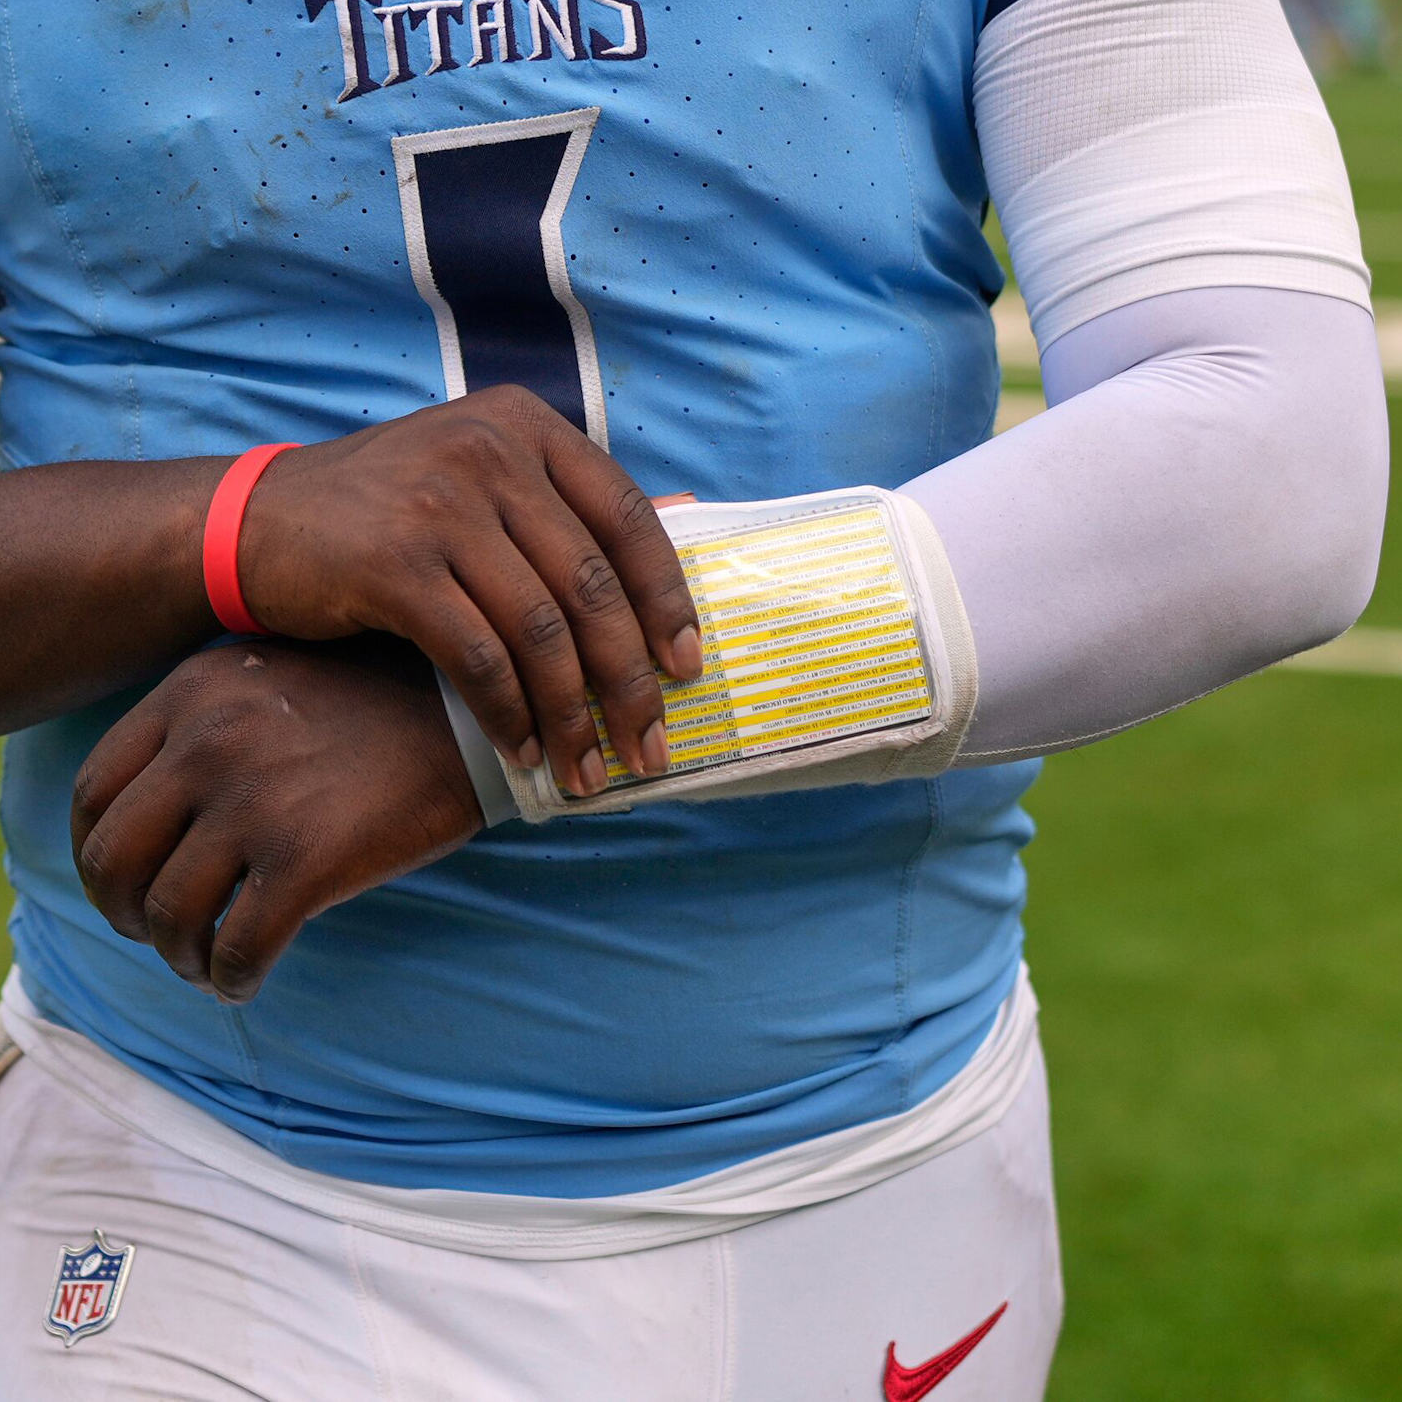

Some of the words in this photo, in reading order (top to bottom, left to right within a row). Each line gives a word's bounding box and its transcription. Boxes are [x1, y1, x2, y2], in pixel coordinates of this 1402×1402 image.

[392, 106, 610, 454] 1
[787, 653, 807, 662] SCREEN
[833, 662, 862, 672] ALCATRAZ
[859, 678, 878, 687] NASTY
[837, 683, 855, 692] FLASH
[781, 695, 801, 704] PABLO
[867, 697, 885, 706] NASTY
[832, 705, 850, 713] FLASH
[807, 711, 824, 719] WASH
[760, 720, 782, 729] SWITCH
[56, 1284, 105, 1324] NFL
